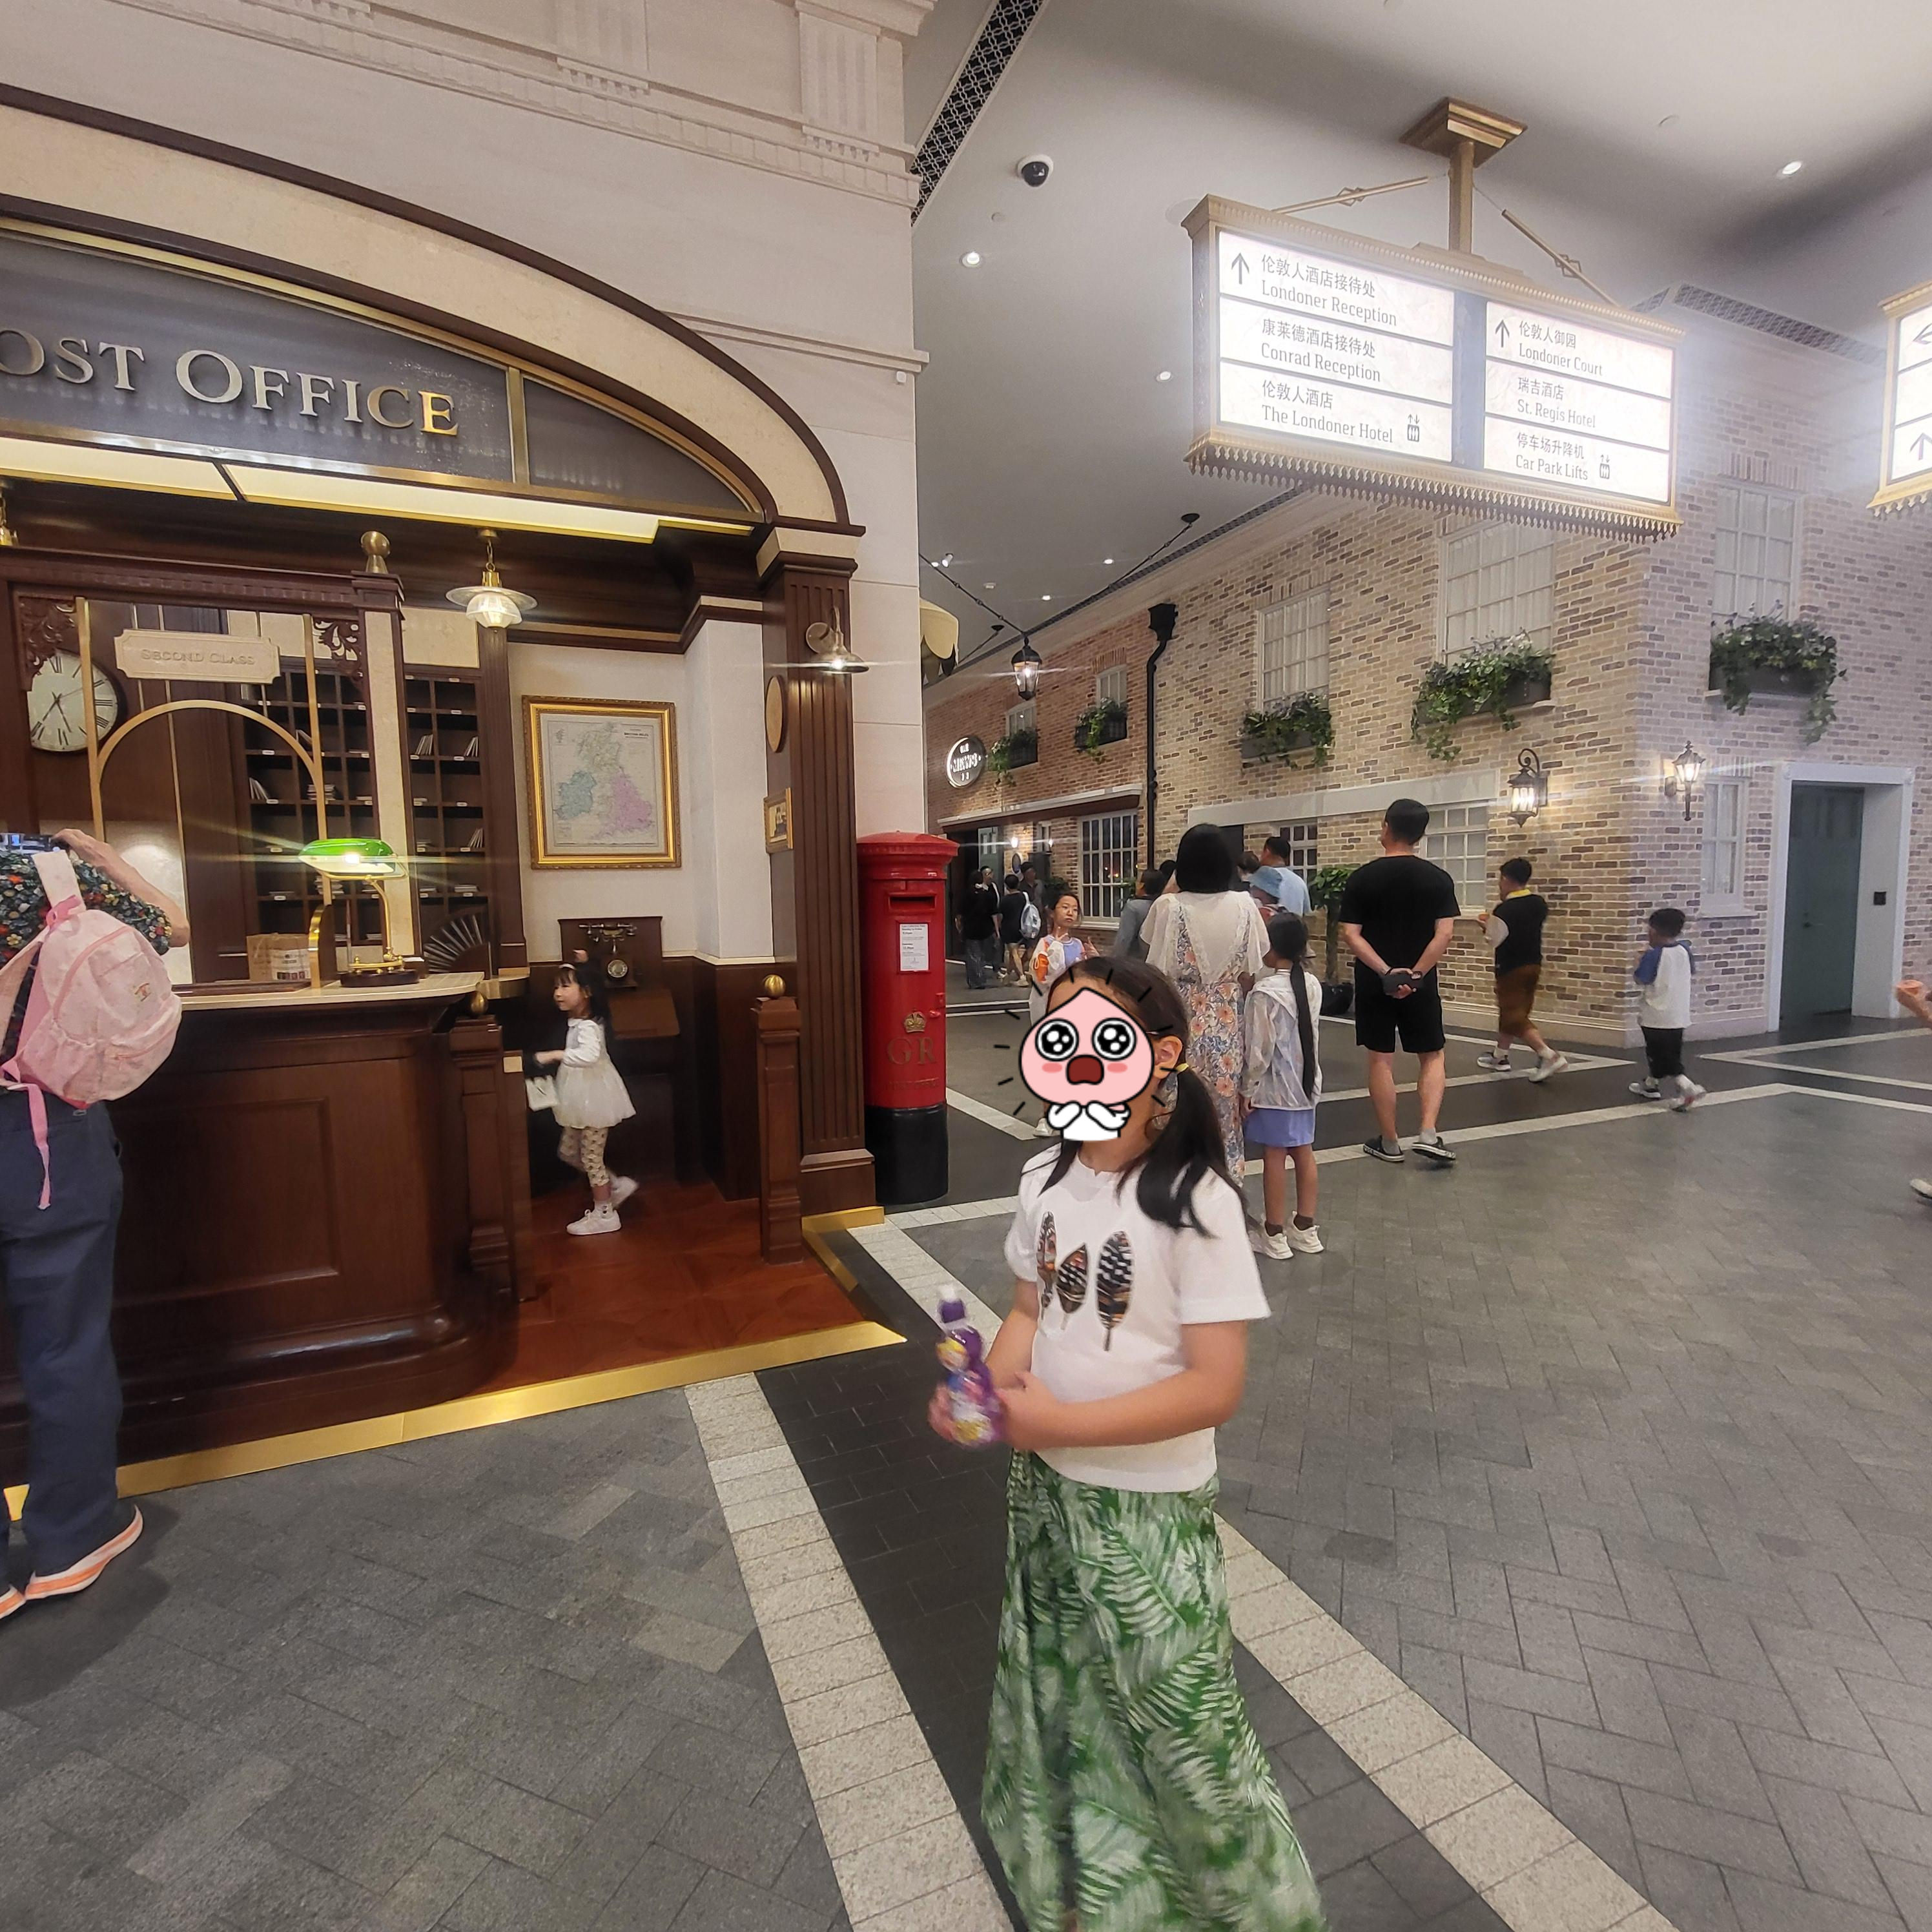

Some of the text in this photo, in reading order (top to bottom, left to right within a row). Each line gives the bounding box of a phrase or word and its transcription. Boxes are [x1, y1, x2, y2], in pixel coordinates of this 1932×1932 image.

[1261, 254, 1375, 298] 伦敦人酒店接待处
[1262, 280, 1397, 326] Londoner Reception
[1262, 318, 1375, 358] 康莱德酒店接待处
[1519, 320, 1576, 349] 伦敦人御园
[1262, 342, 1381, 382] Conrad Reception
[1519, 343, 1603, 376] Londoner Court
[176, 349, 458, 437] OFFICE
[1262, 379, 1333, 410] 伦敦人酒店
[1517, 376, 1564, 400] 瑞吉酒店
[1262, 404, 1393, 443] The Londoner Hotel
[1517, 398, 1596, 428] St. Regis Hotel
[1517, 431, 1585, 459] 停车场升降机
[1516, 455, 1588, 480] Car Park Lifts
[141, 649, 256, 665] SECOND CLASS
[887, 1036, 938, 1065] GR
